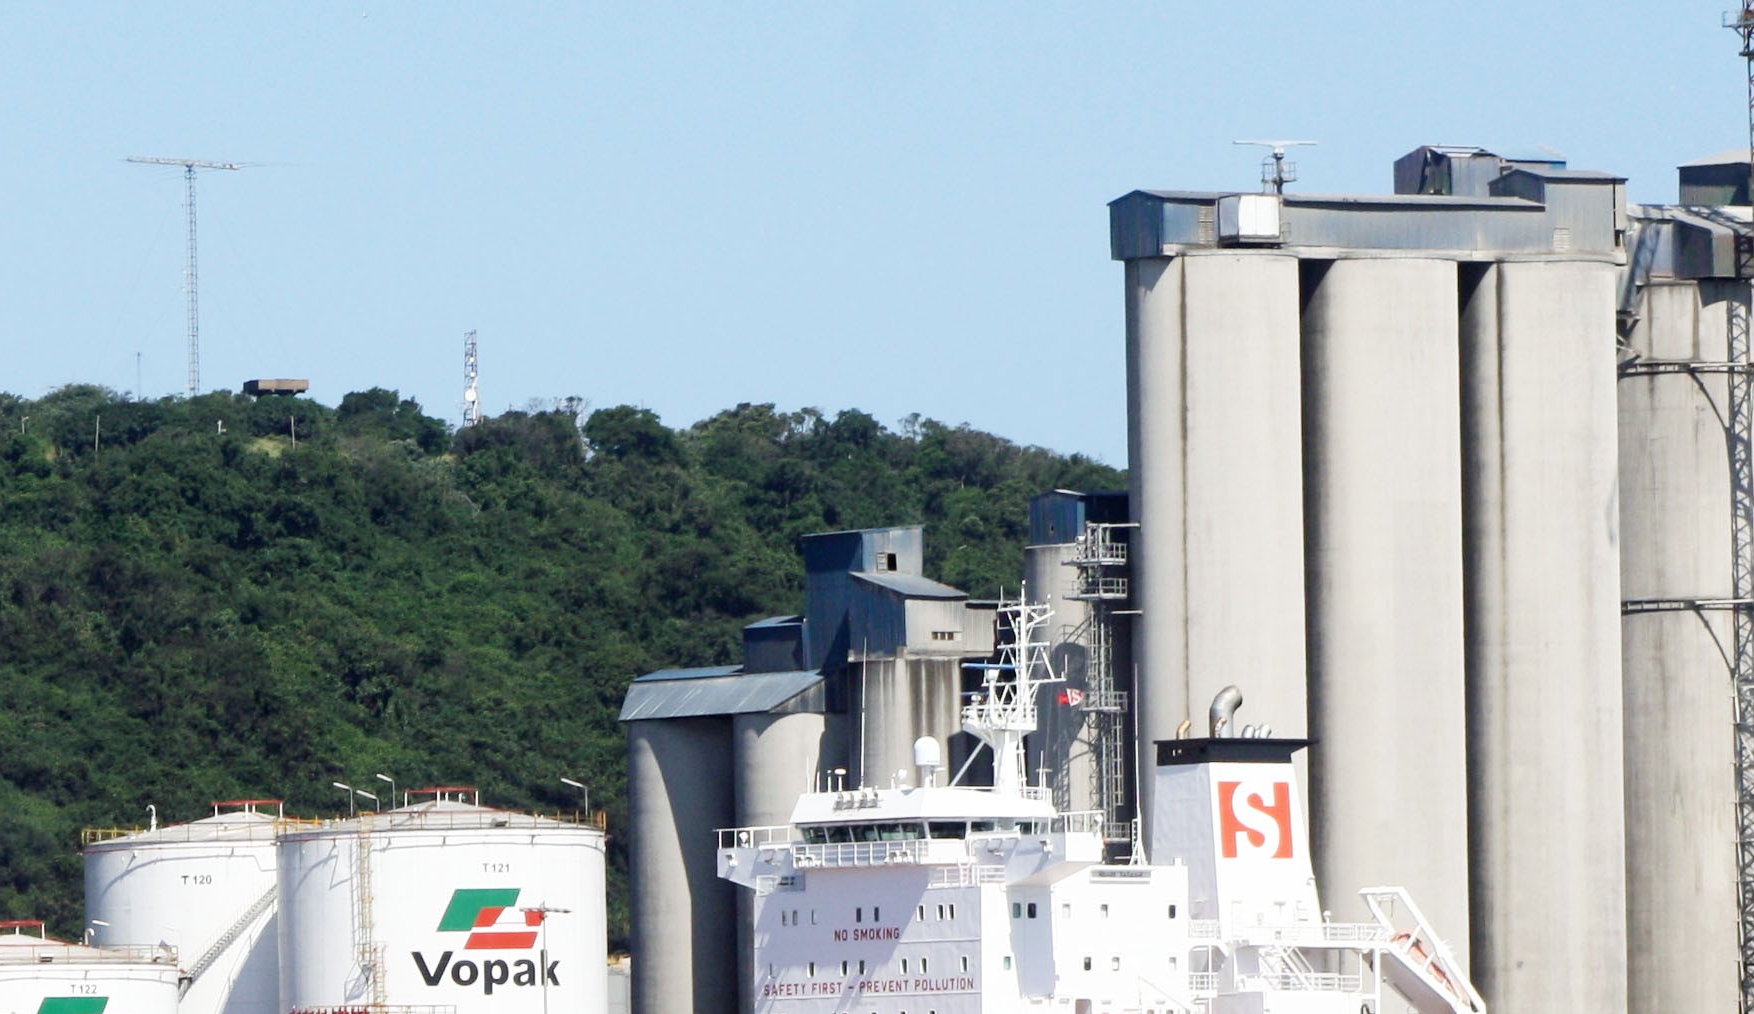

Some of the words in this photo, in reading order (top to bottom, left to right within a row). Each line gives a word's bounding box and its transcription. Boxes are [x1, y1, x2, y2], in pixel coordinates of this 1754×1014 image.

[834, 928, 848, 942] NO
[853, 927, 900, 941] SMOKING
[411, 949, 560, 995] Vopak
[764, 982, 806, 997] SAFETY
[811, 981, 843, 995] FIRST
[859, 980, 908, 993] PREVENT
[914, 977, 974, 992] POLLUTION
